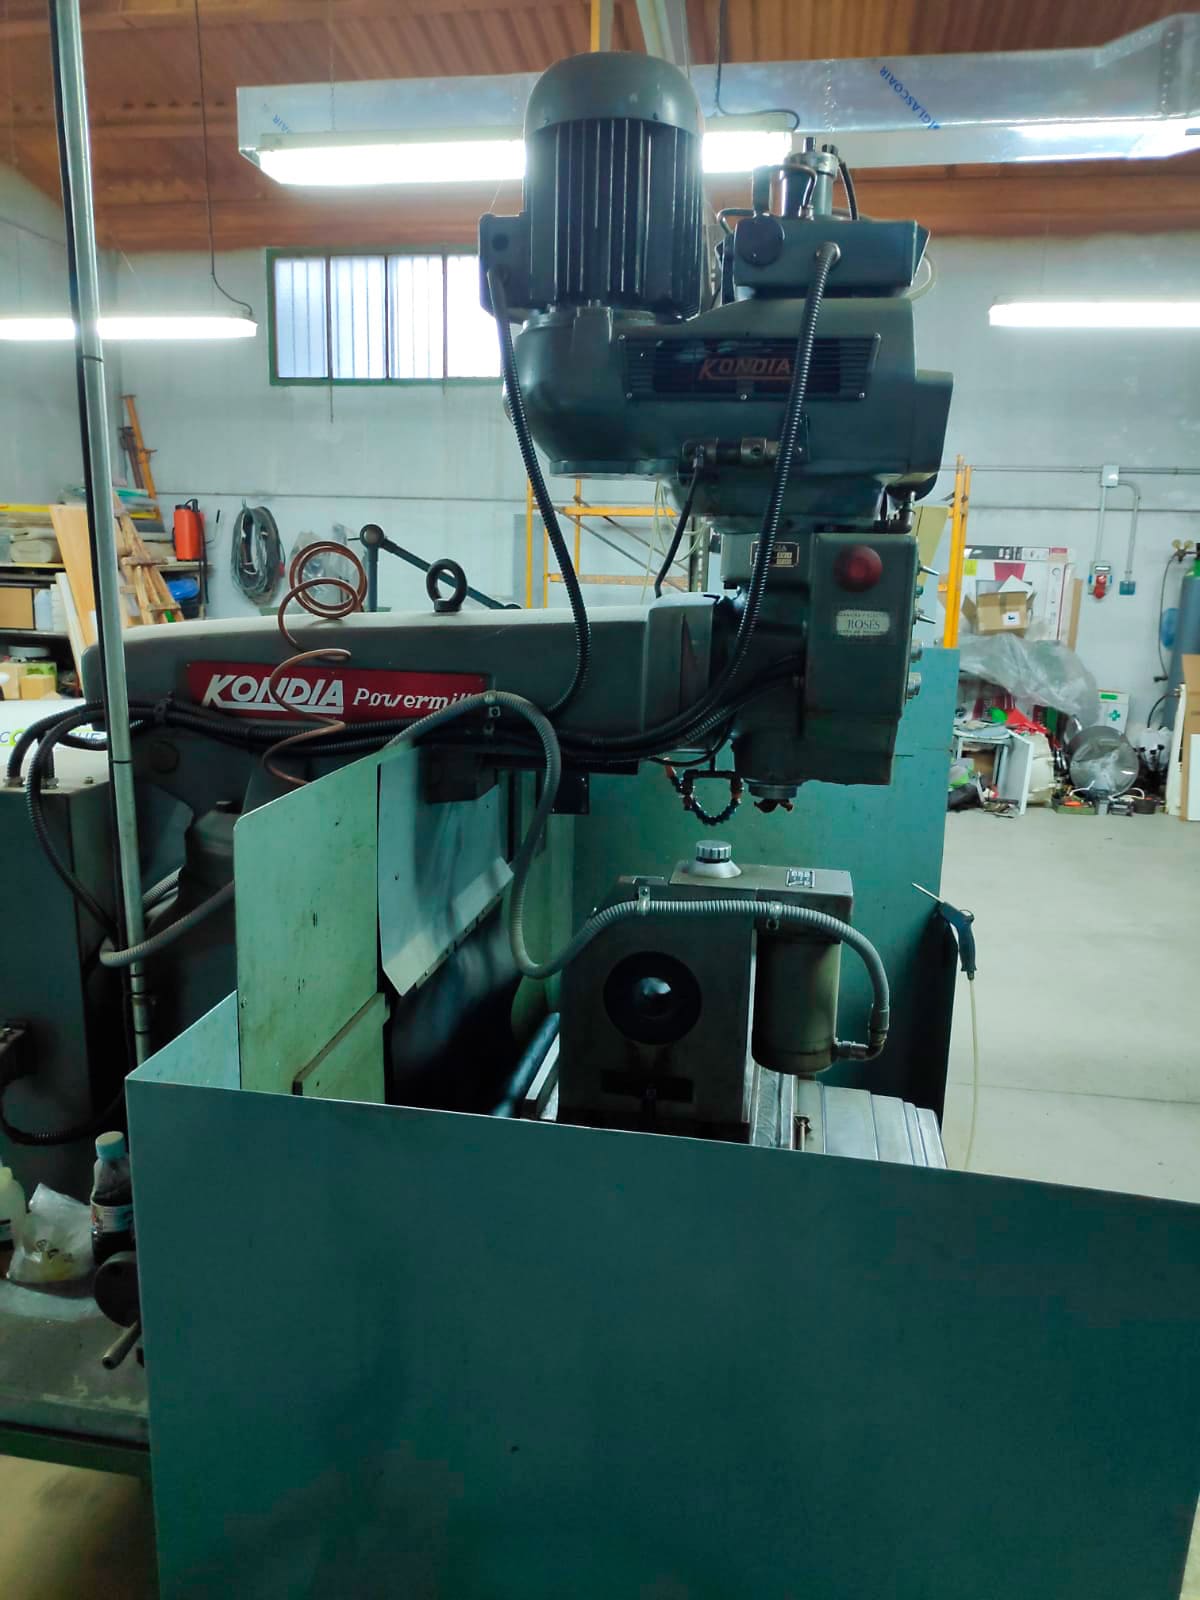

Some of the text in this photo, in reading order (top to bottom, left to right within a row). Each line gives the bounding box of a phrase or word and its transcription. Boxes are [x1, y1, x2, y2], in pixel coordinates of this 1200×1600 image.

[699, 357, 792, 380] KONDIA
[201, 674, 472, 714] KONDIA Powermi
